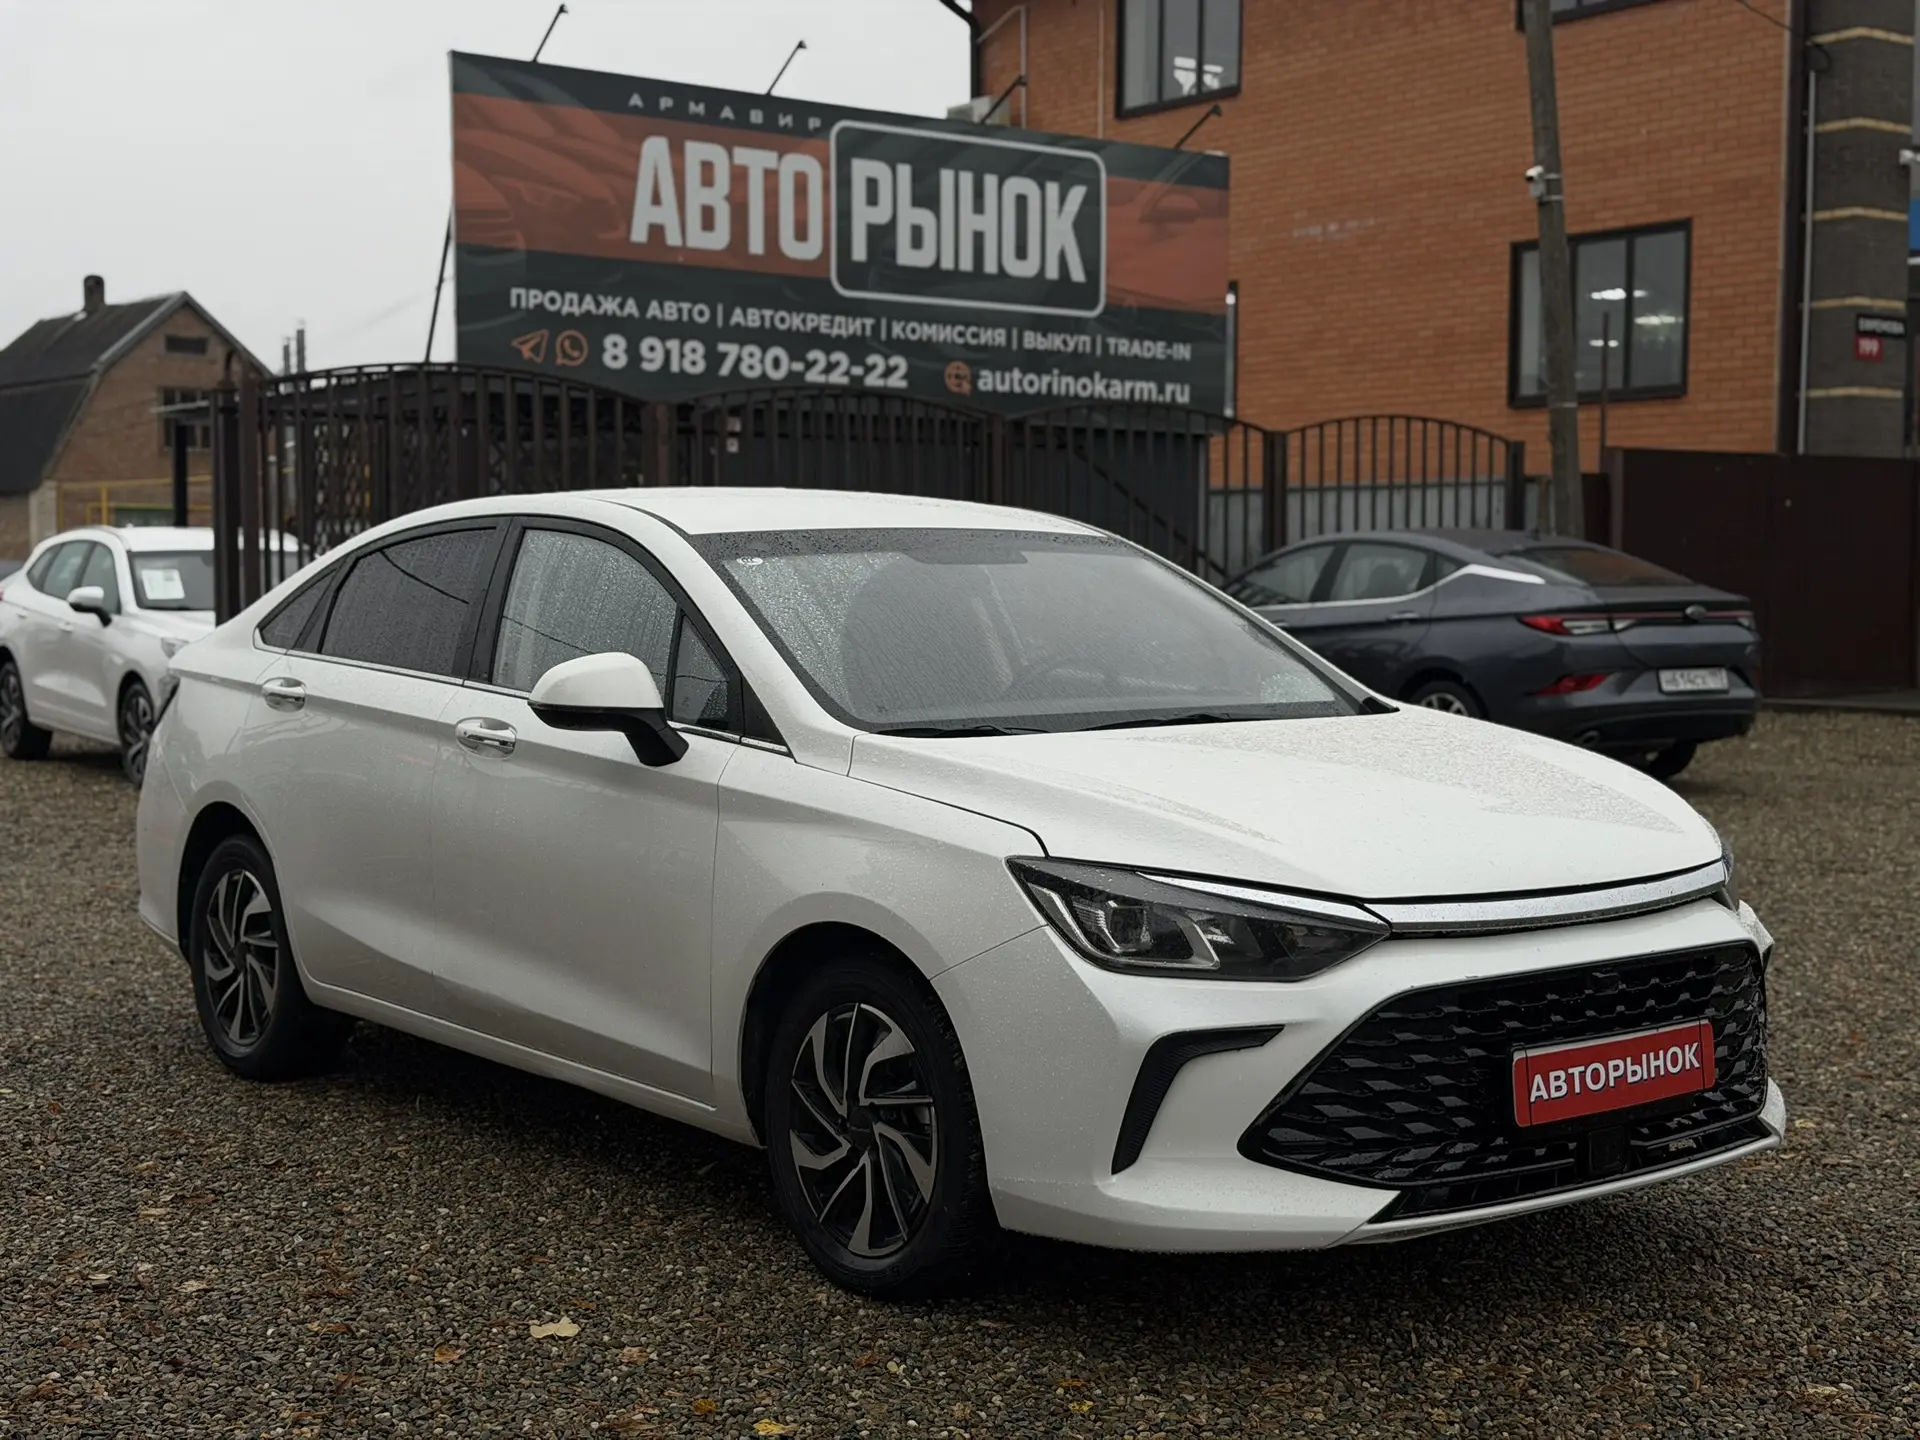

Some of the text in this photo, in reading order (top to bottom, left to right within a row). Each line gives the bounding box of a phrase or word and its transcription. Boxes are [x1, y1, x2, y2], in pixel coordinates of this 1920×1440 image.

[628, 92, 822, 131] АРМАВИР
[630, 135, 1088, 283] АВТО РЫНОК
[510, 288, 1191, 361] ПРОДАЖА АВТО АВТОКРЕДИТ КОМИССИЯ ВЫКУП TRADE-IN
[602, 334, 1191, 404] 8 918 780-22-22 autorinokarm.ru
[1530, 1042, 1700, 1103] АВТОРЫНОК
